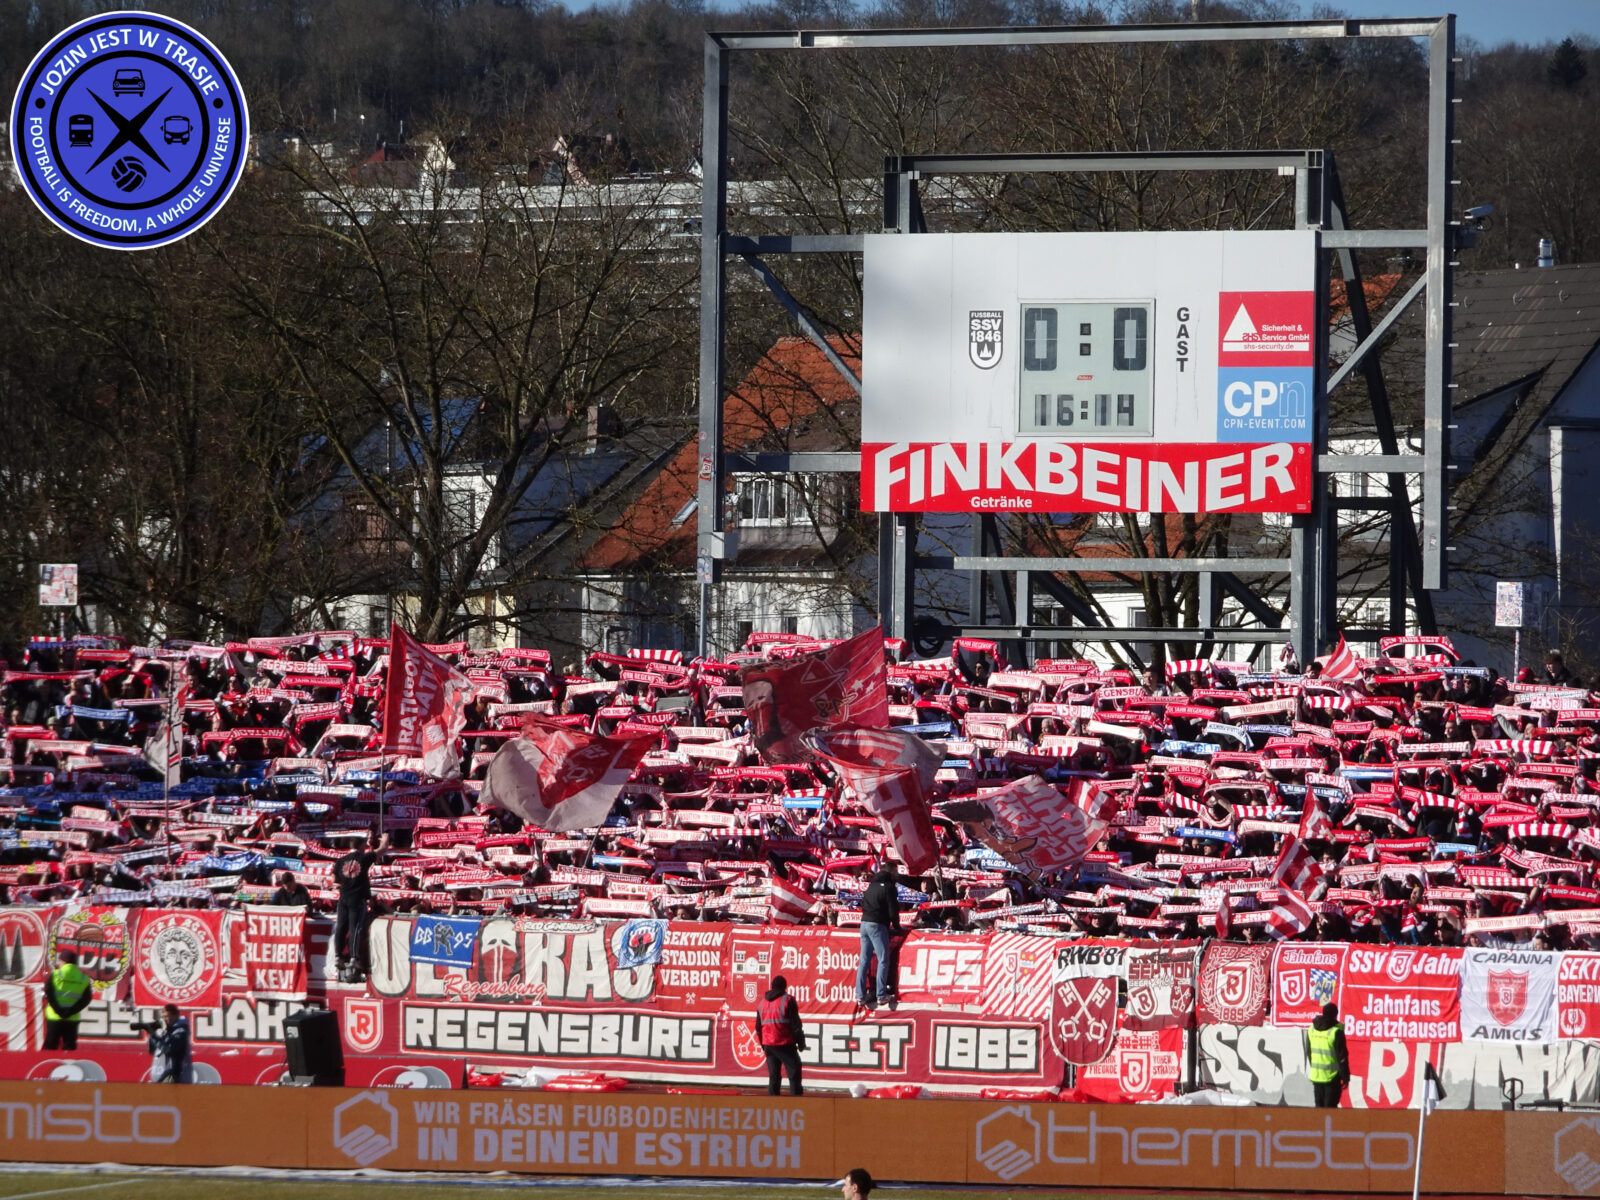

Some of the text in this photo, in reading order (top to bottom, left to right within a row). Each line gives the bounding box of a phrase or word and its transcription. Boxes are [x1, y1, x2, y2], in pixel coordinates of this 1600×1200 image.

[971, 319, 1002, 331] SSV
[1262, 324, 1296, 332] Sicherheit
[970, 330, 1002, 342] 1846
[1176, 306, 1190, 372] GAST
[1262, 333, 1287, 341] Service
[1288, 333, 1310, 341] GmbH
[1243, 343, 1295, 351] shs-security.de
[1223, 419, 1306, 429] CPN-EVENT.COM
[874, 442, 1296, 513] FINKBEINER
[970, 496, 1033, 510] Getränke
[247, 915, 303, 937] STARK
[415, 926, 433, 946] BB
[664, 931, 724, 947] SEKTION
[246, 942, 306, 963] BLEIBEN
[661, 950, 721, 967] STADION
[781, 945, 860, 975] Die Powe
[1473, 952, 1553, 965] CAPANNA
[900, 949, 984, 986] JGS
[1349, 950, 1463, 976] SSV Jahn
[254, 968, 295, 990] KEV!
[443, 973, 548, 1001] Regensburg
[660, 969, 721, 987] VERBOT
[787, 985, 810, 1003] om
[1220, 1007, 1244, 1022] 1889
[1362, 993, 1441, 1017] Jahnfans
[405, 1006, 711, 1061] REGENSBURG
[1344, 1014, 1457, 1039] Beratzhausen
[1471, 1024, 1543, 1041] AMICIS
[935, 1025, 1038, 1071] 1889
[1089, 1064, 1118, 1075] FREUNDE
[413, 1101, 460, 1125] WIR
[469, 1098, 563, 1127] FRÄSEN
[573, 1105, 806, 1131] FUßBODENHEIZUNG
[417, 1127, 619, 1165] IN DEINEN
[1048, 1109, 1414, 1170] thermisto
